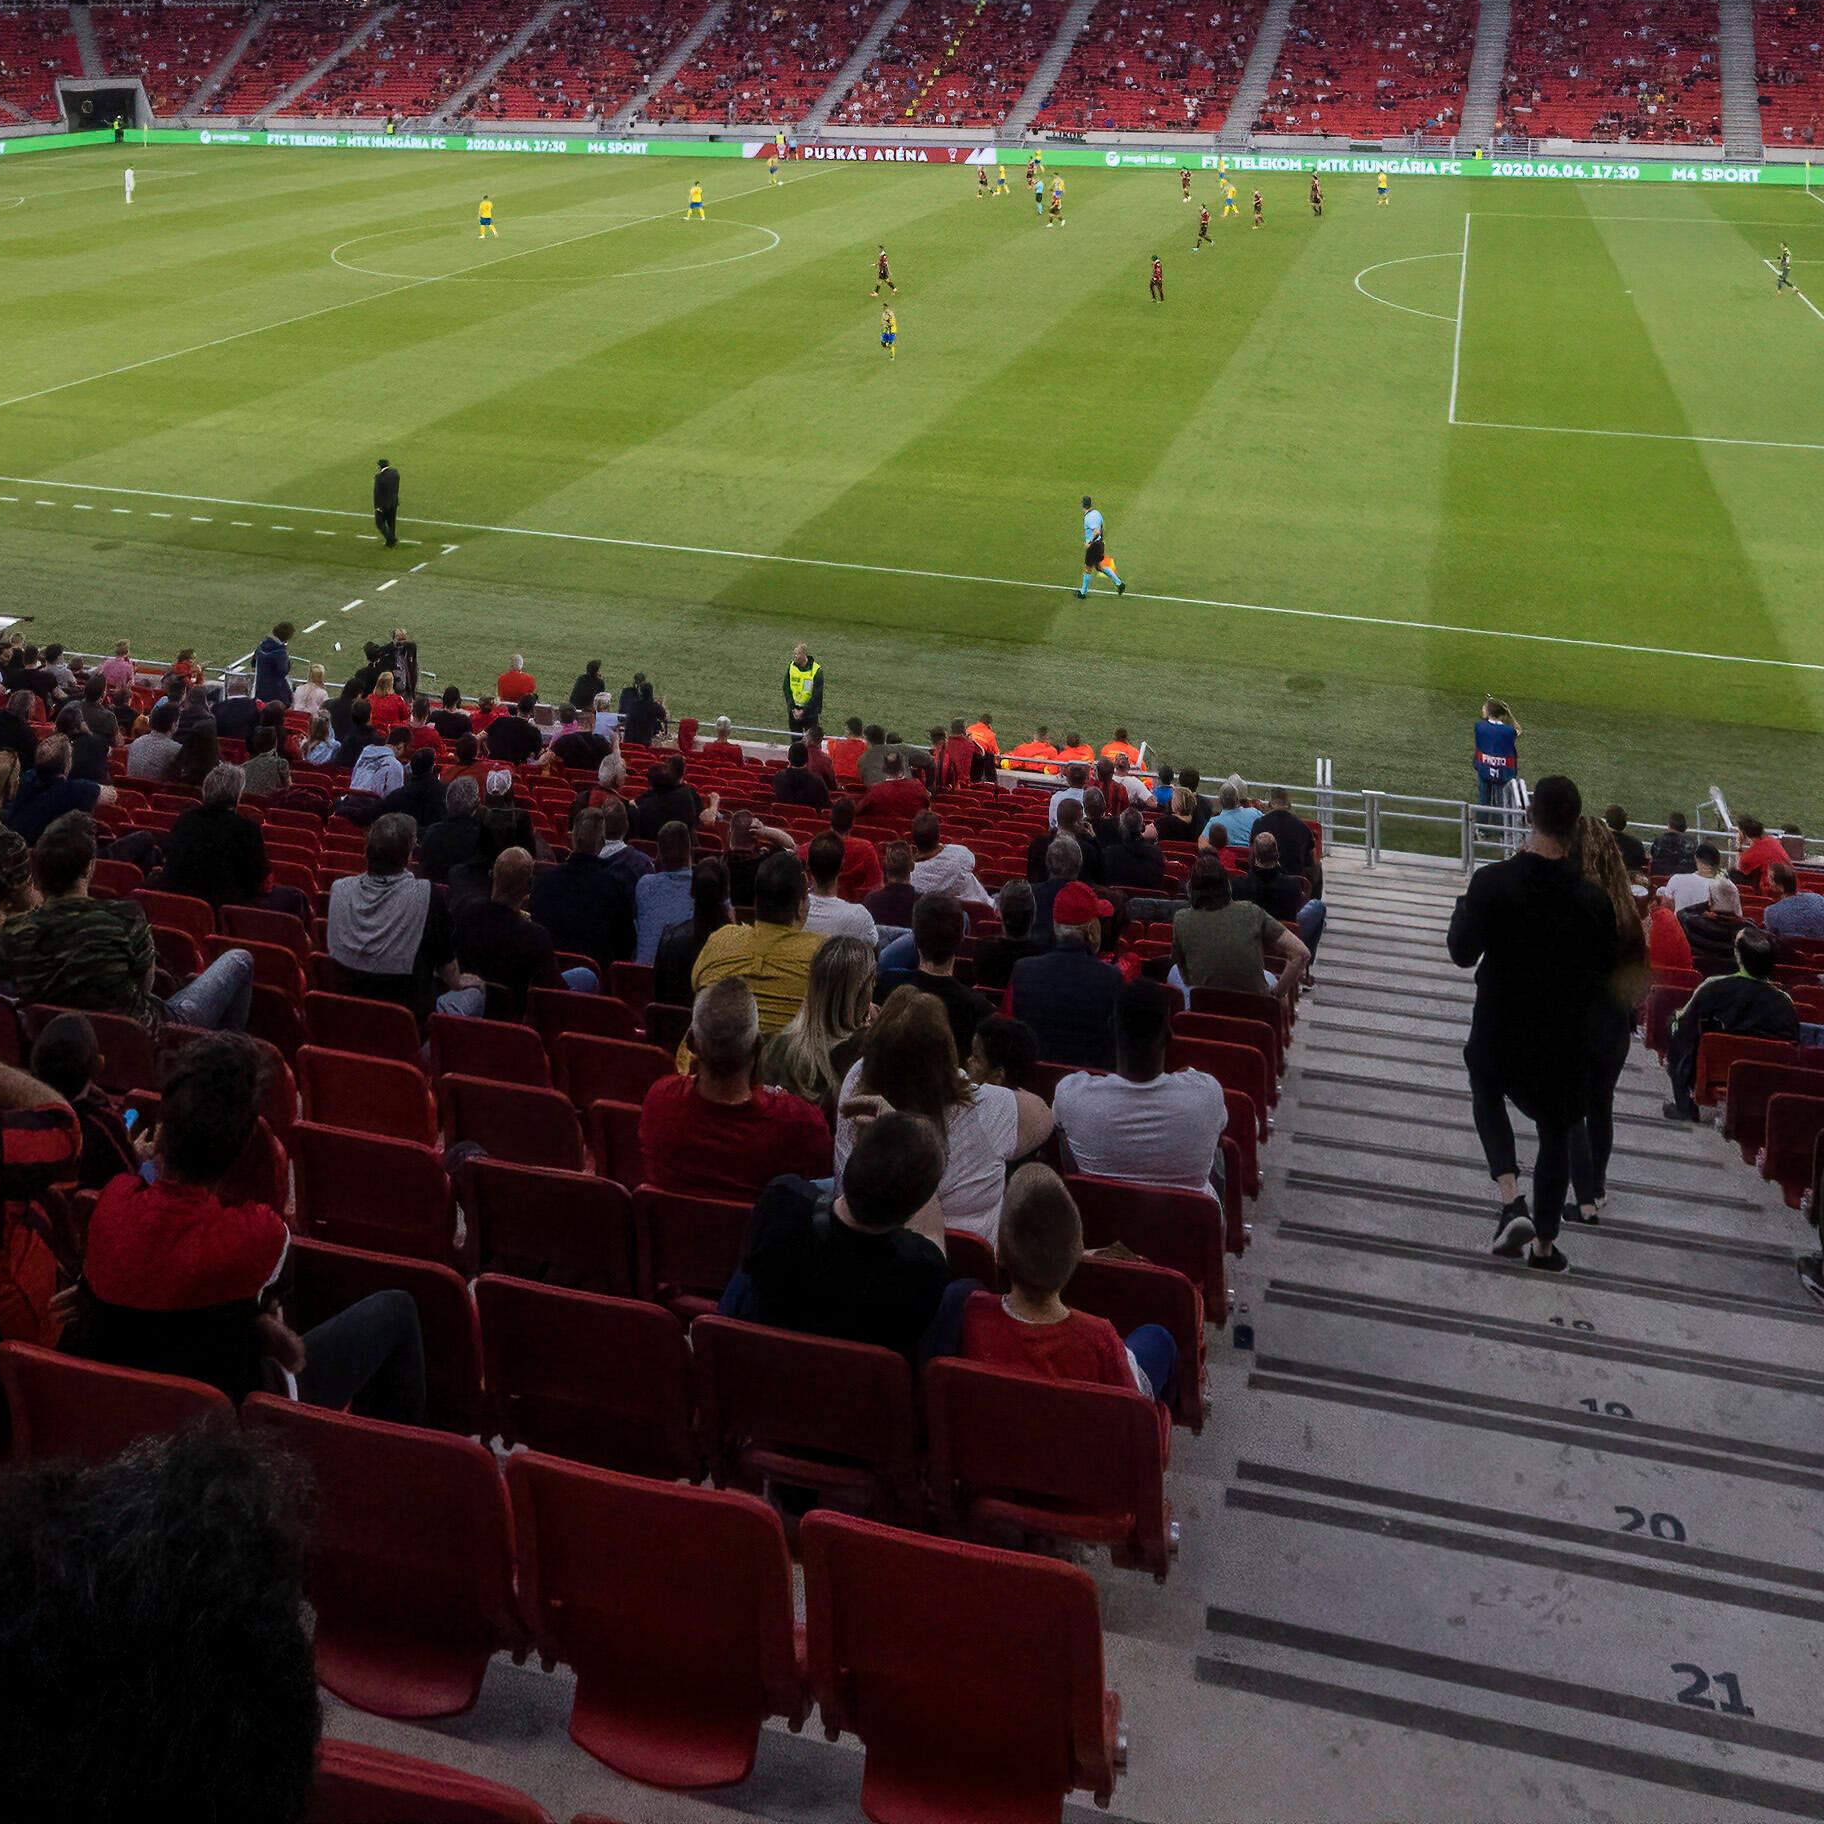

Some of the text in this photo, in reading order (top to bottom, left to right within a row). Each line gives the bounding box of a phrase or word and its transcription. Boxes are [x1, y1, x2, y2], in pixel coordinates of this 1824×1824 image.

[431, 137, 447, 149] FC
[607, 142, 648, 154] SPORT
[804, 145, 929, 162] PUSKÁS ARÉNA
[1234, 157, 1302, 171] TELEKOM
[1317, 159, 1349, 172] MTK
[1440, 162, 1463, 175] FC
[1490, 163, 1588, 179] 2020.06.04.
[1592, 164, 1641, 180] 17:30
[1671, 167, 1698, 181] M4
[1701, 167, 1761, 183] SPORT
[1481, 753, 1507, 767] PHOTO
[1614, 1505, 1687, 1542] 20
[1670, 1662, 1755, 1718] 21
